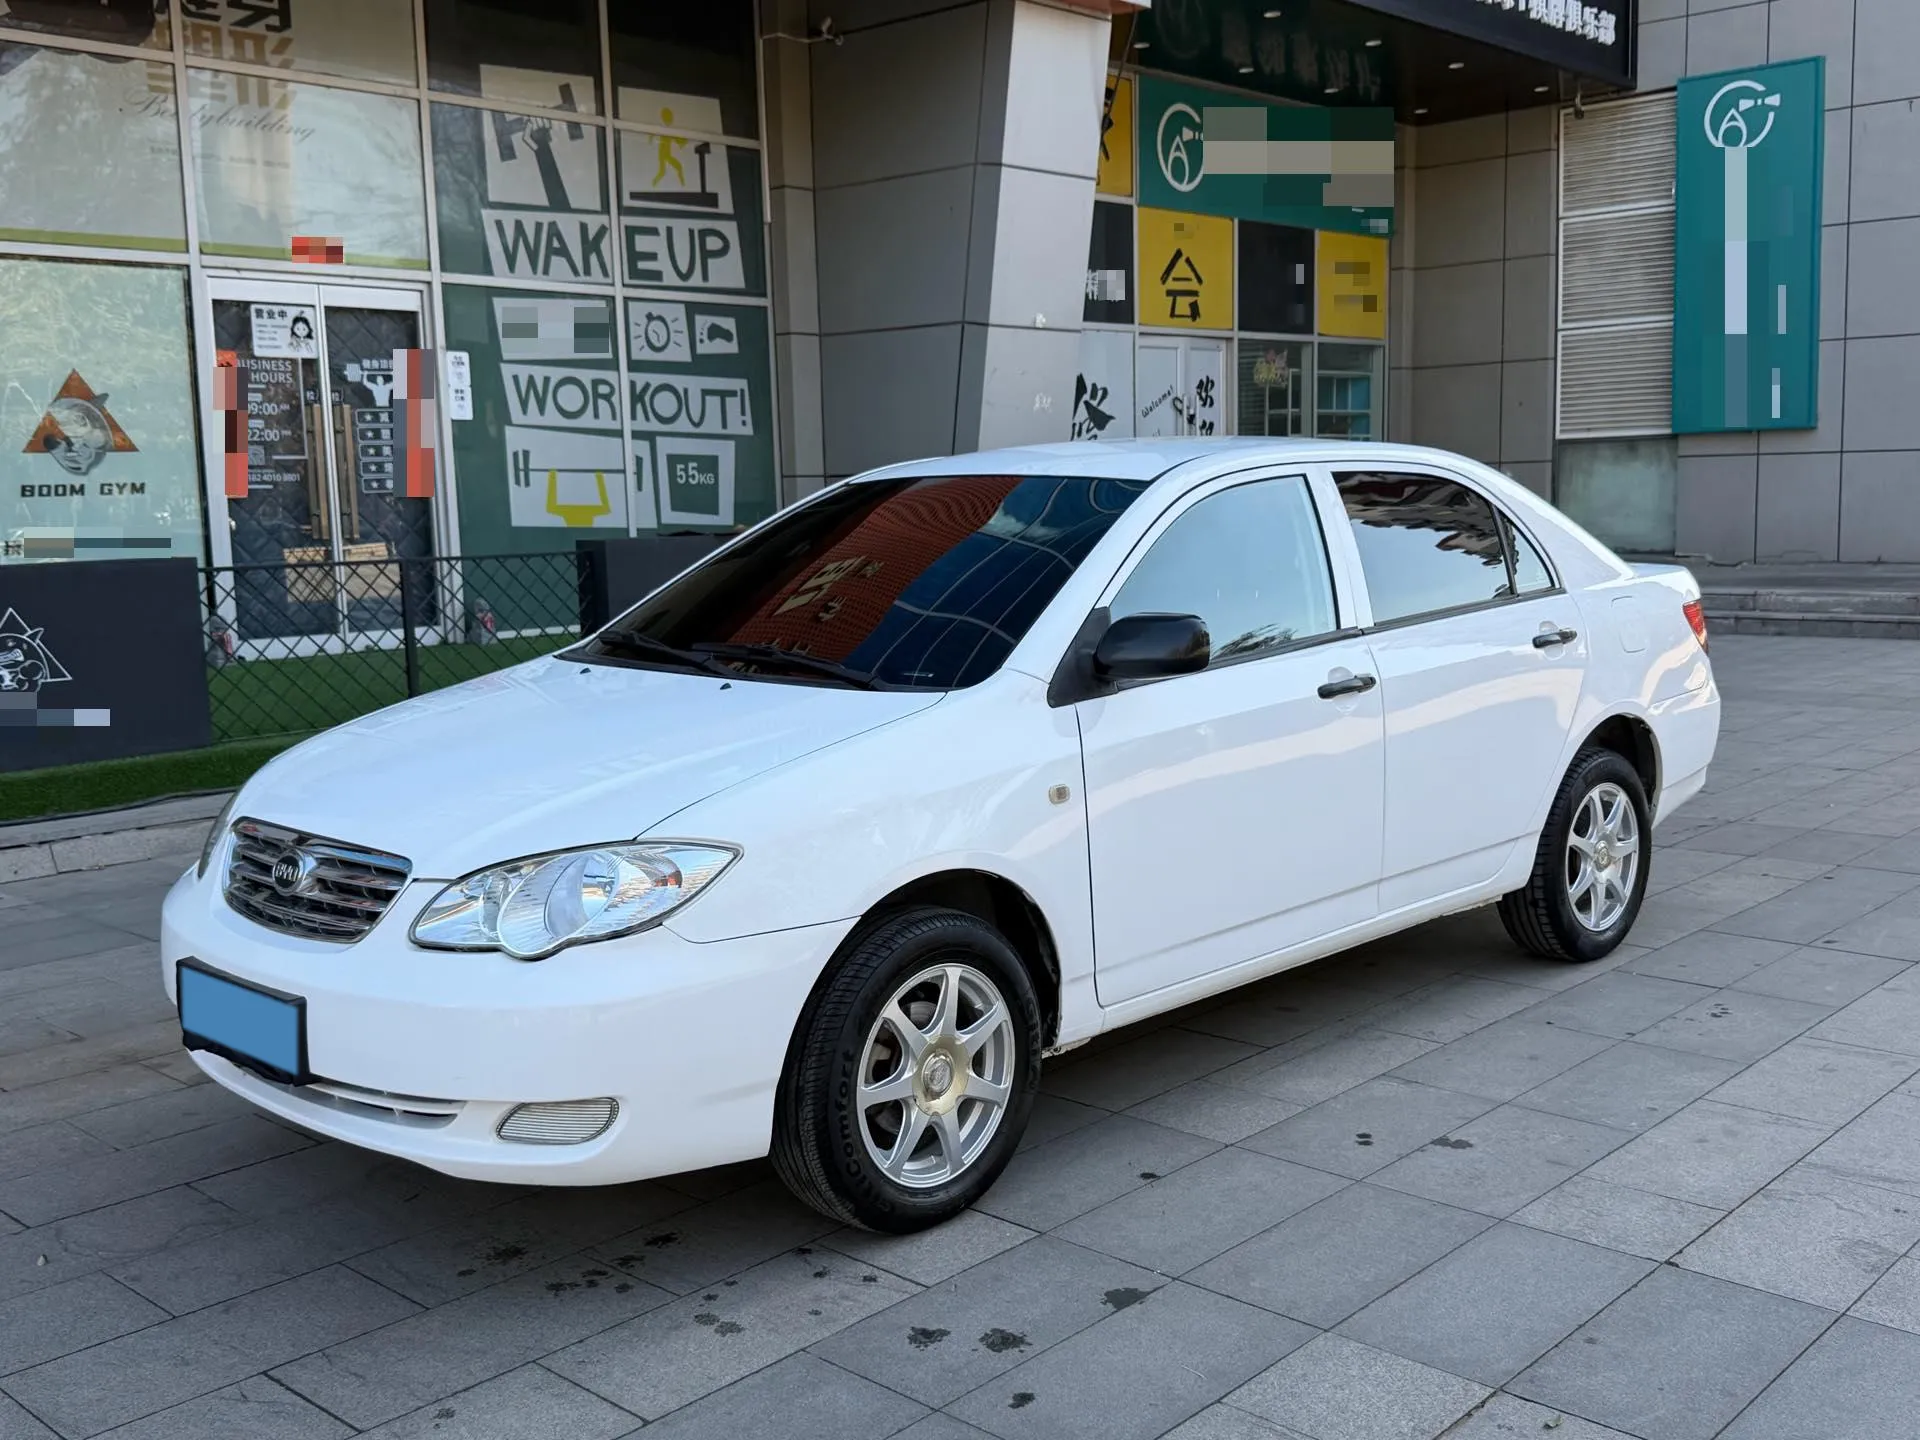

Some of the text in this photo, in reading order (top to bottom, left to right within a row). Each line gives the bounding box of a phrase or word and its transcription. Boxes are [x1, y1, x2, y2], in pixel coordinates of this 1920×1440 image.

[1160, 247, 1203, 322] 会
[255, 308, 289, 320] 营业中
[251, 371, 293, 384] HOURS
[513, 373, 748, 430] WORKOUT!
[676, 461, 715, 486] 55KG
[20, 481, 146, 498] BOOM GYM
